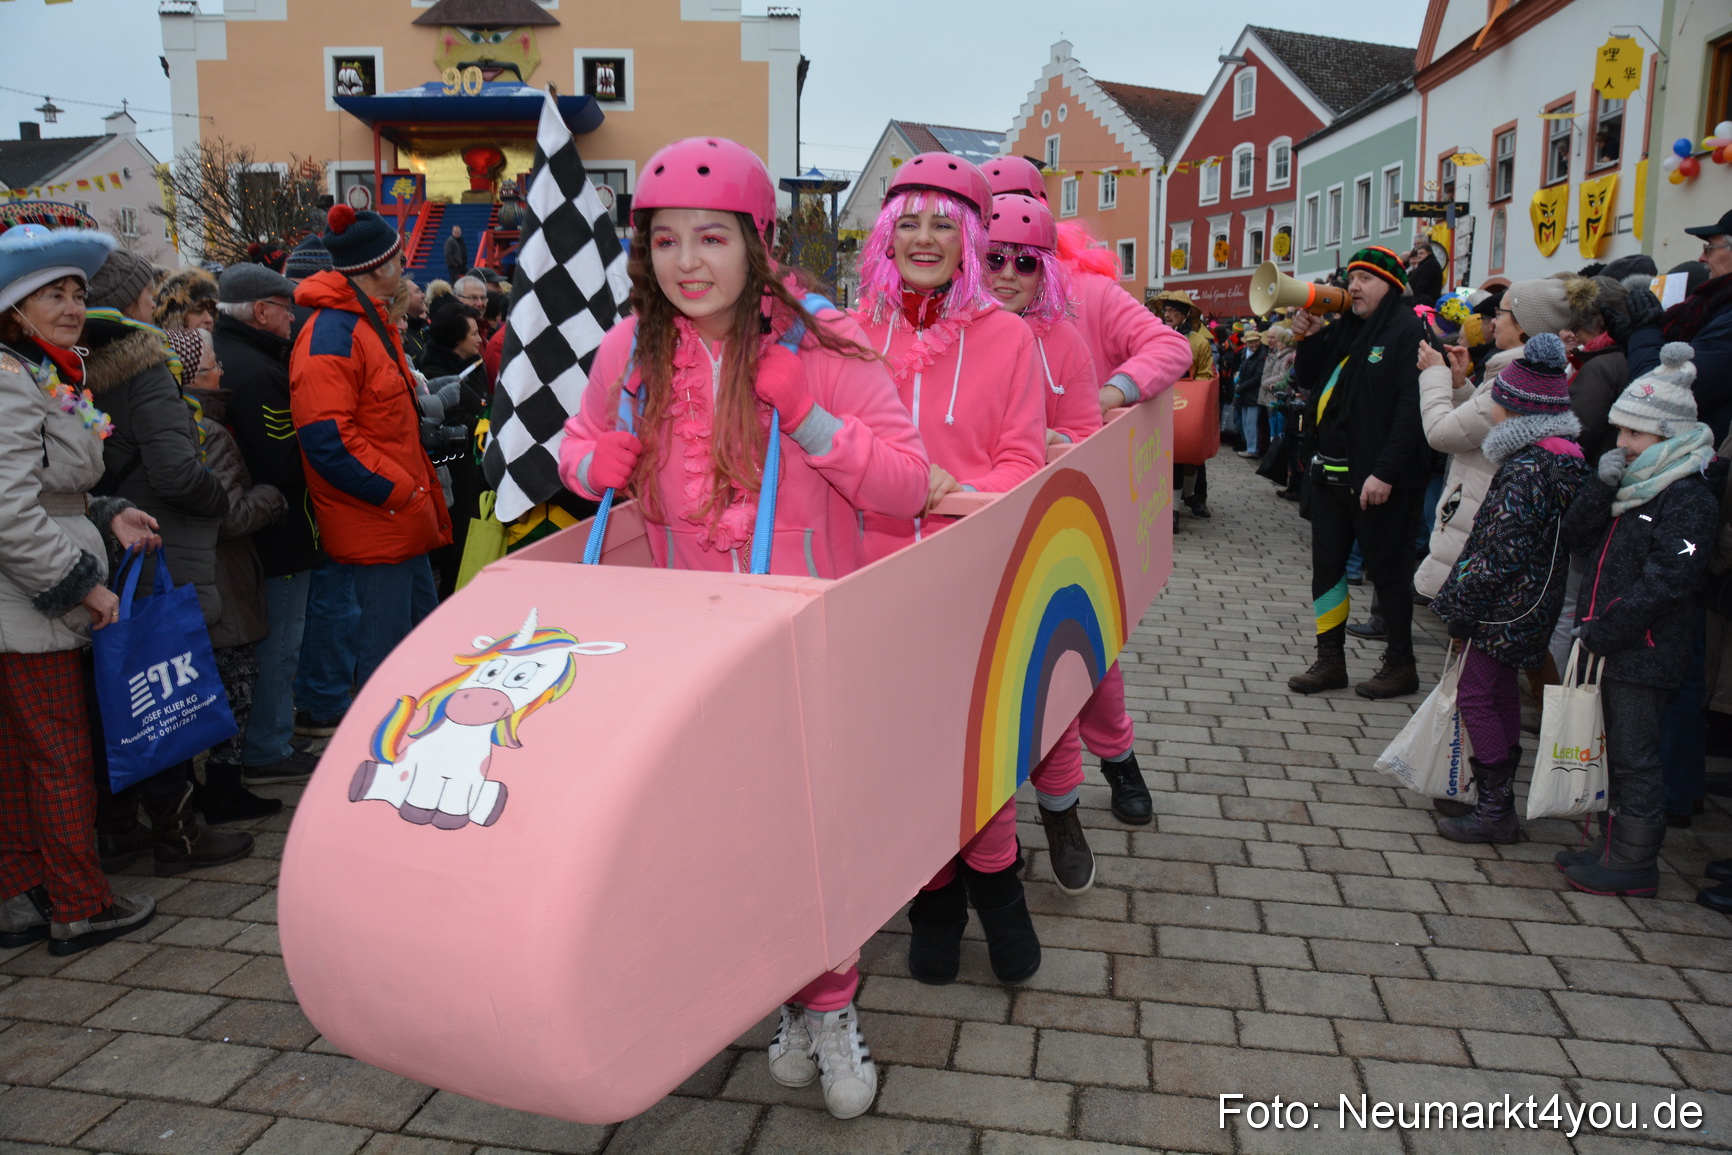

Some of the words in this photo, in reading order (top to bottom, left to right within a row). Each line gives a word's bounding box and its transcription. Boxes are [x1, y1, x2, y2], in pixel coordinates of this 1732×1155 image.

[442, 65, 483, 96] 90
[1603, 76, 1615, 89] 人
[147, 651, 199, 701] JK
[142, 709, 163, 727] JOSEF
[163, 700, 185, 716] KLIER
[185, 694, 199, 706] KG
[159, 715, 178, 728] Lyren
[181, 694, 218, 718] Glockenspiele
[147, 732, 159, 743] Tel.
